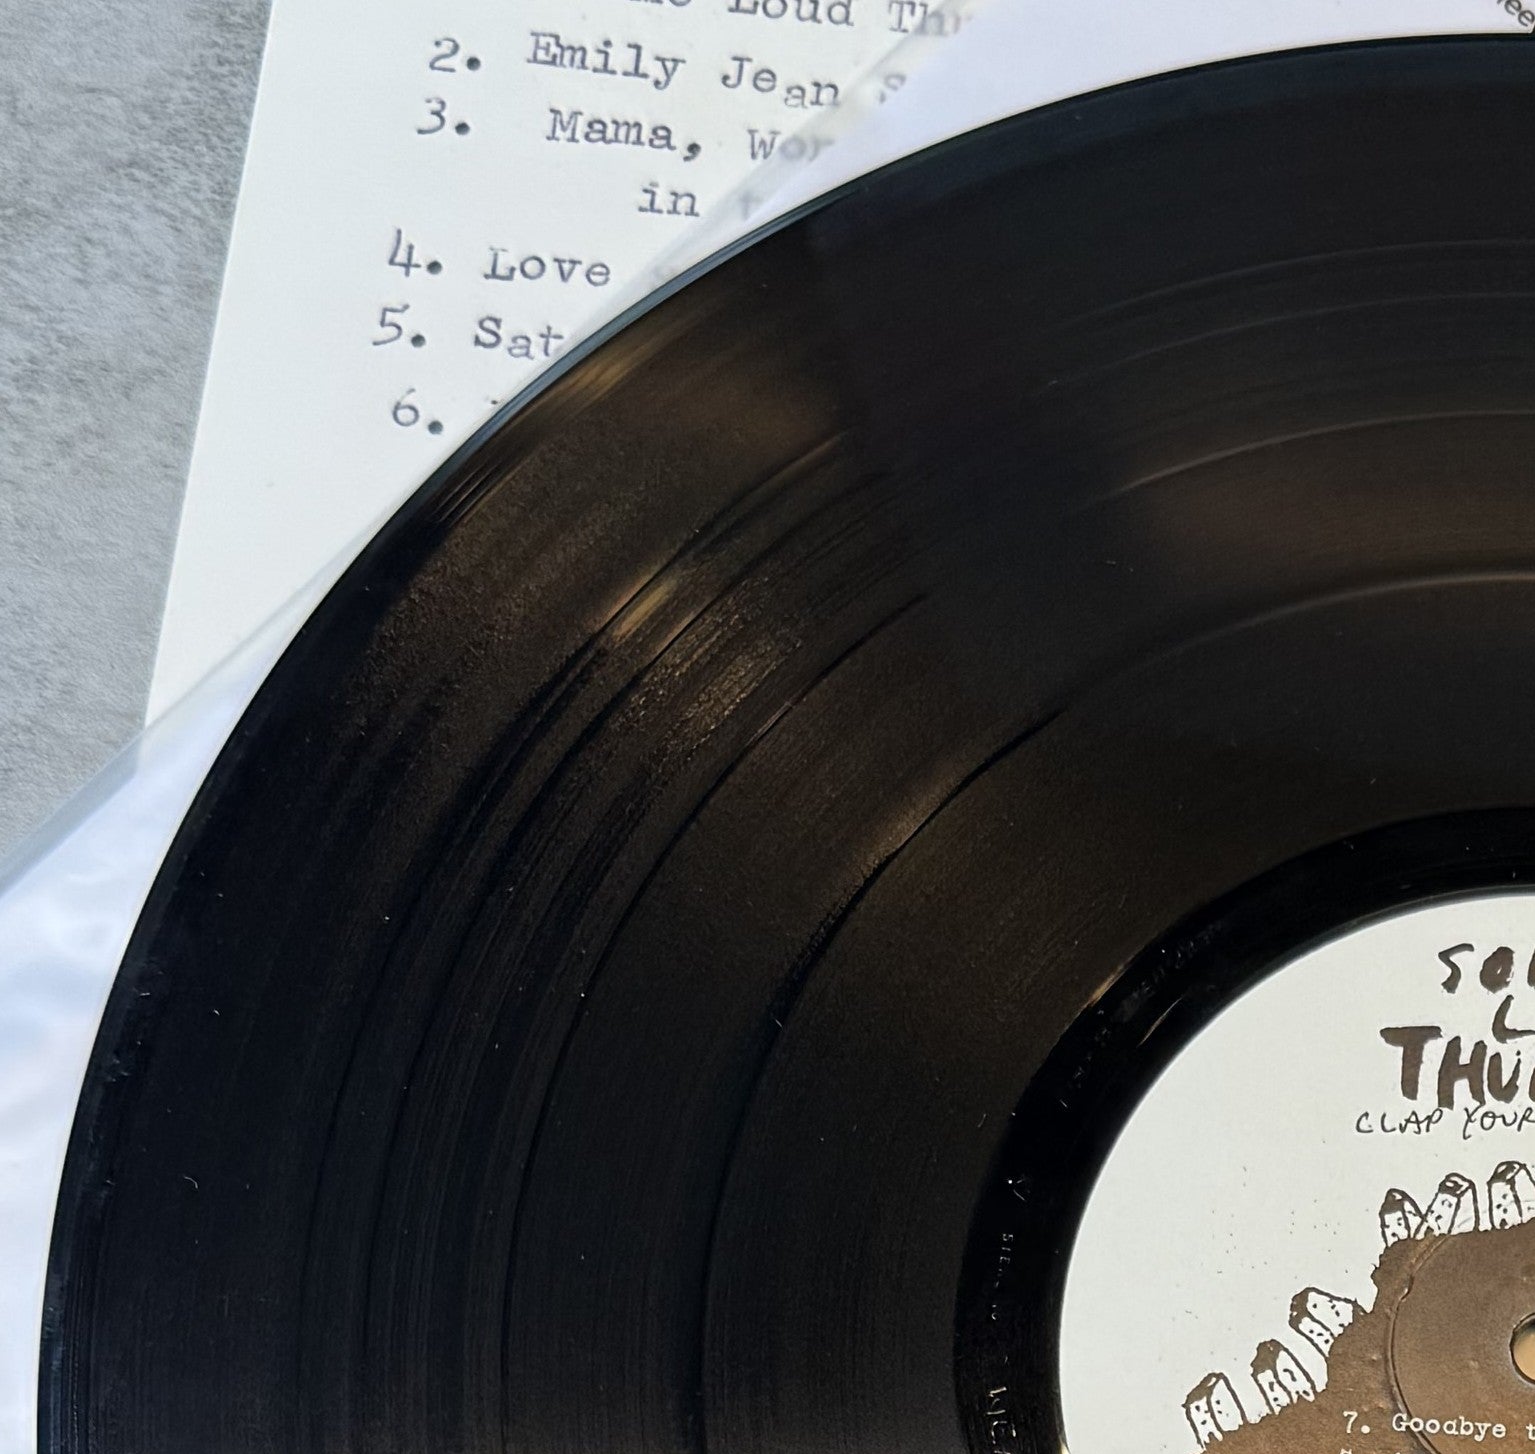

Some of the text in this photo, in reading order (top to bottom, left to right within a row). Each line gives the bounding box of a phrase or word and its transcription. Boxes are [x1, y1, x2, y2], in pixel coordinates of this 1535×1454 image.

[428, 37, 481, 73] 2.
[526, 30, 686, 91] Emily
[721, 56, 840, 109] Jean
[416, 97, 470, 135] 3.
[545, 107, 702, 162] Mama,
[637, 182, 700, 217] in
[388, 228, 443, 277] 4.
[484, 246, 611, 287] Love
[372, 303, 565, 360] 5. Sat
[392, 387, 443, 435] 6.
[1355, 1107, 1444, 1134] CLAP
[1343, 1411, 1370, 1434] 7.
[1392, 1412, 1507, 1442] Goodbye
